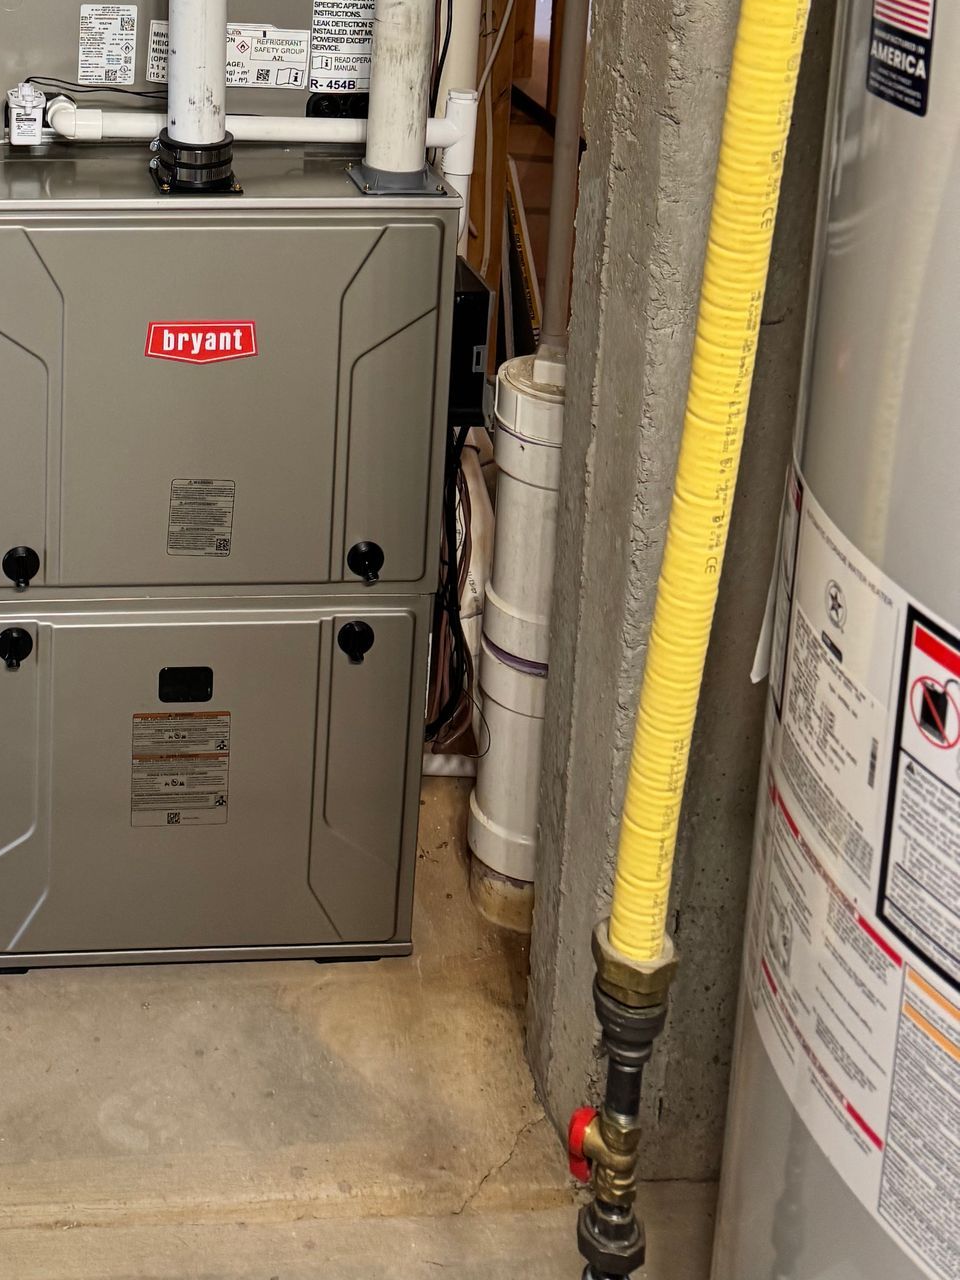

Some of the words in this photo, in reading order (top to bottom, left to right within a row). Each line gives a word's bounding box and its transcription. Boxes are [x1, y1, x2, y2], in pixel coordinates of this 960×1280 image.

[314, 1, 343, 9] SPECIFIC
[313, 10, 361, 18] INSTRUCTIONS.
[313, 19, 330, 27] LEAK
[331, 20, 367, 28] DETECTION
[256, 39, 303, 47] REFRIGERANT
[254, 46, 279, 54] SAFETY
[280, 47, 305, 55] GROUP
[311, 44, 340, 52] SERVICE.
[870, 39, 927, 80] AMERICA
[326, 80, 356, 90] 454B
[163, 328, 243, 355] bryant
